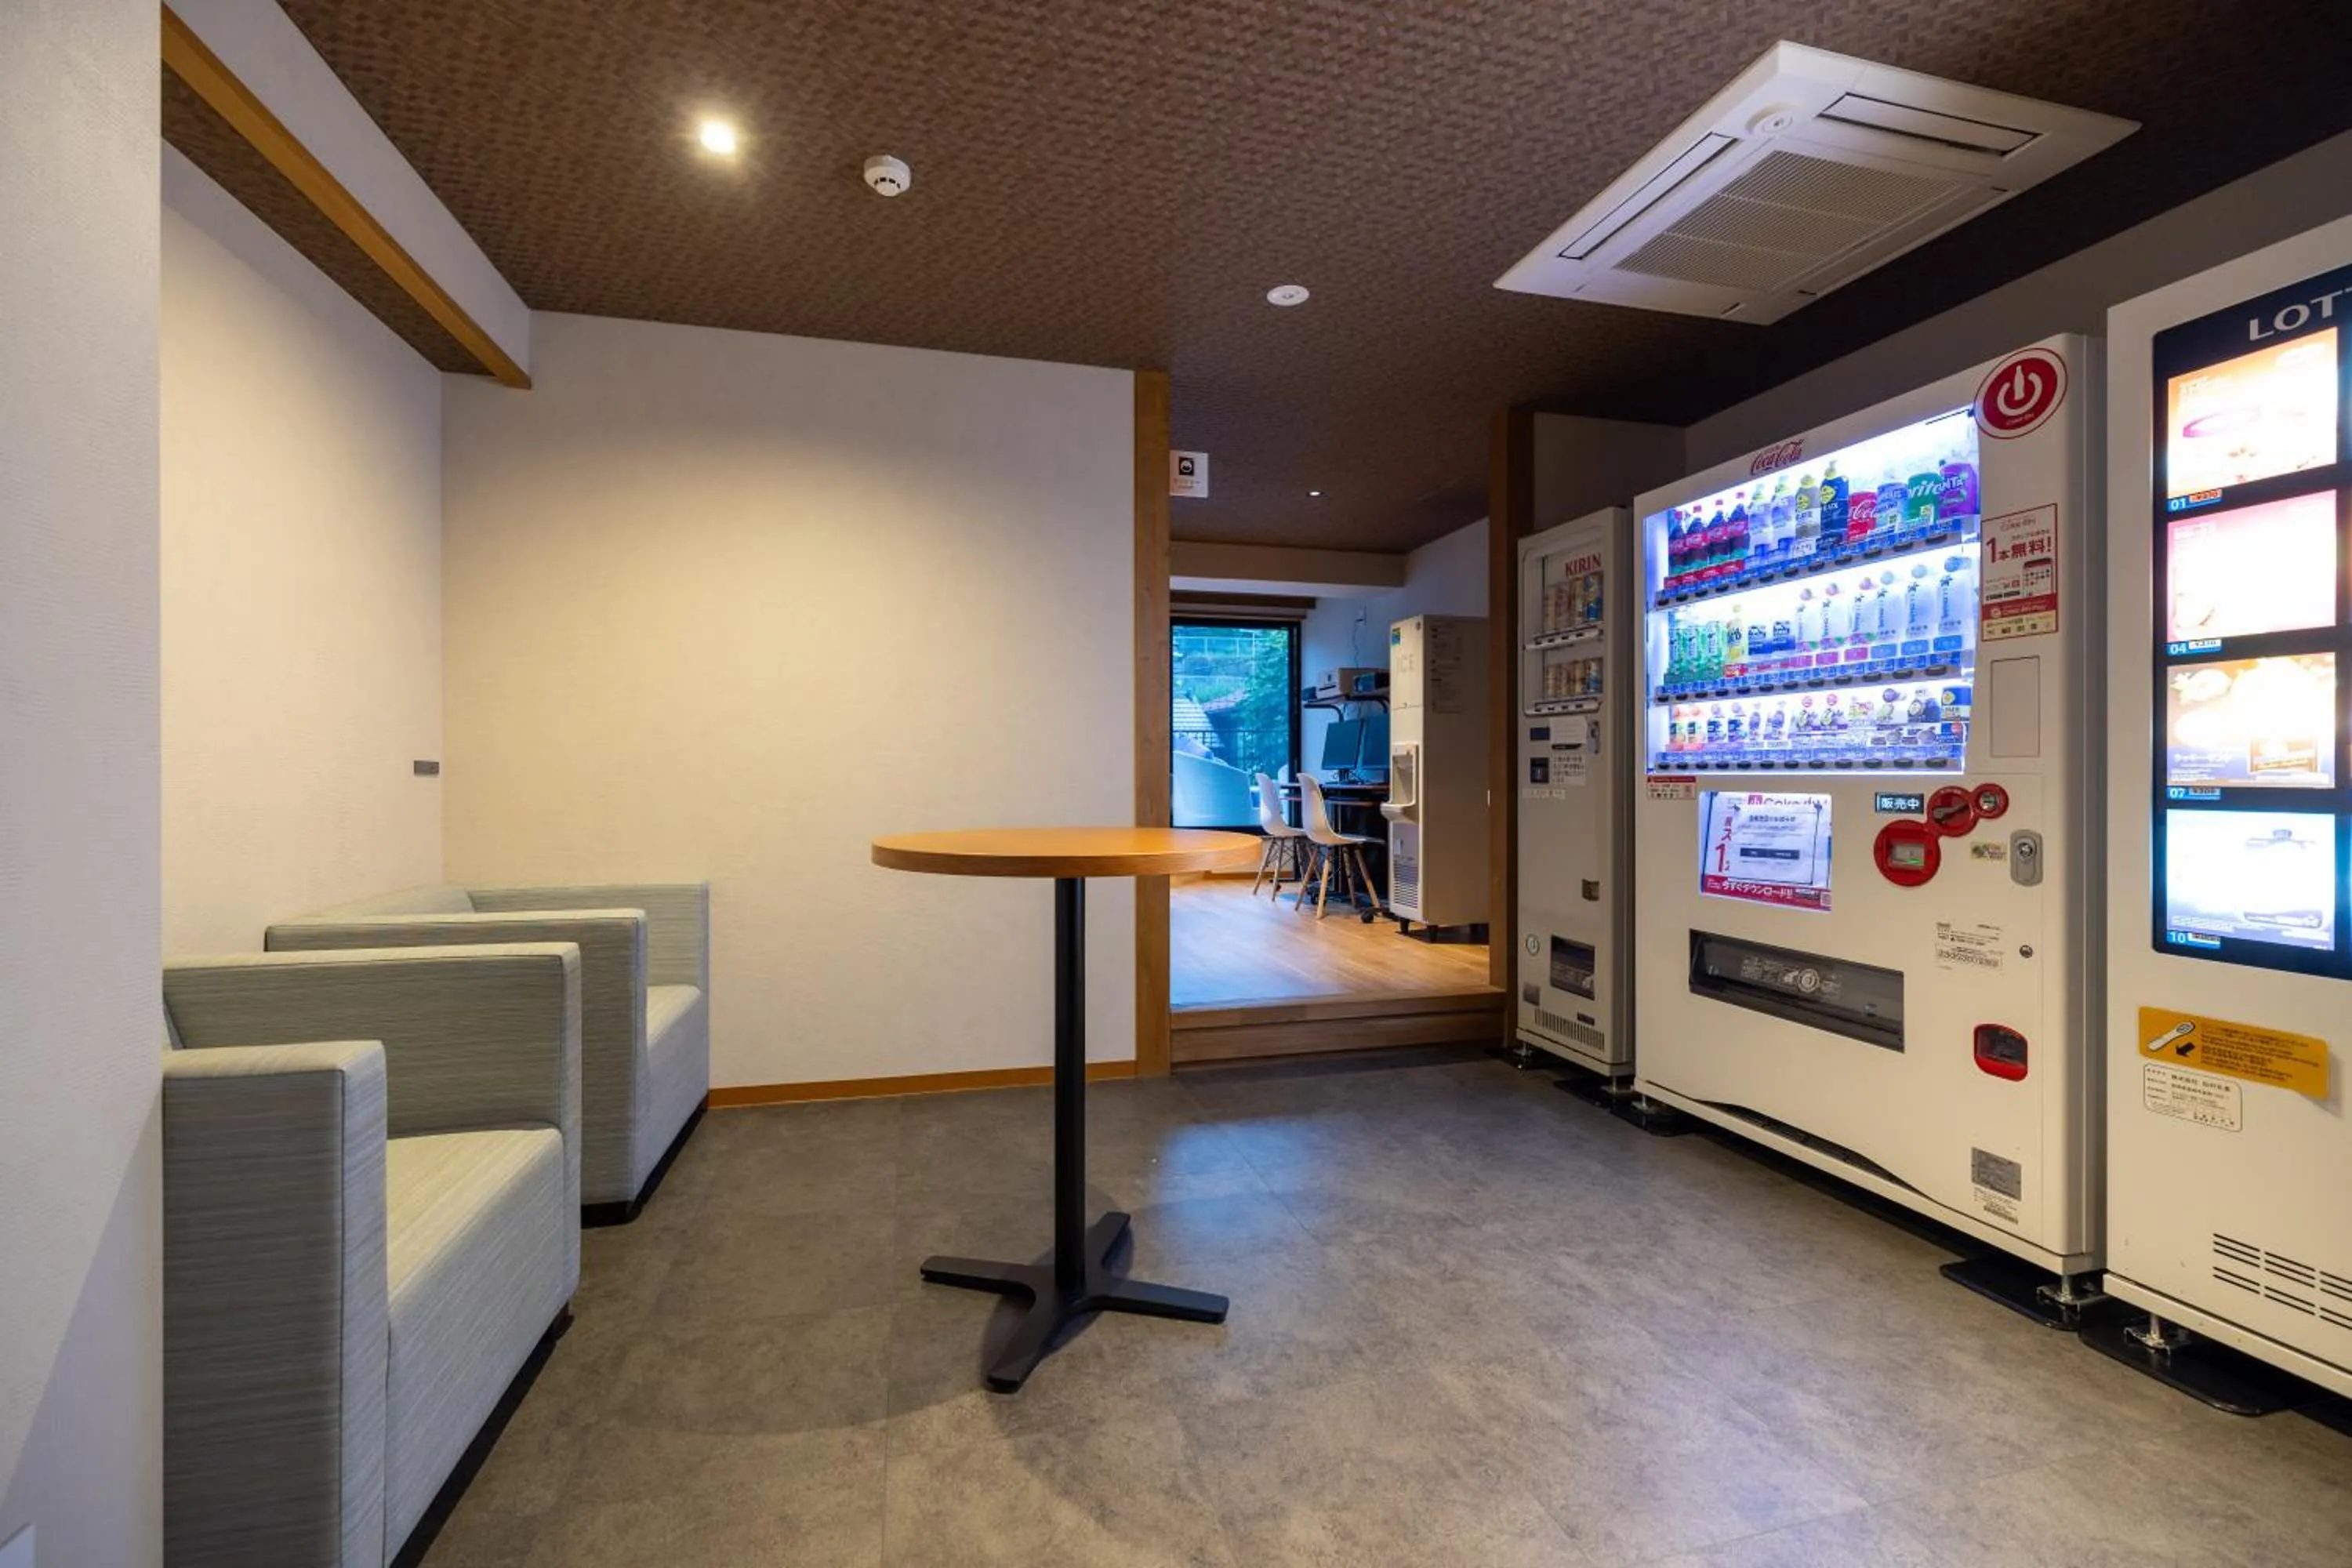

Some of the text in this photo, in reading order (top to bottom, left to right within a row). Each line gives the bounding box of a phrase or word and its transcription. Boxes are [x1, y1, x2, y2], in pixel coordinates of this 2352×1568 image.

[2249, 287, 2352, 340] LOT
[1751, 439, 1804, 475] Coca-Cola
[1565, 552, 1602, 578] KIRIN
[1881, 797, 1920, 810] 販売中
